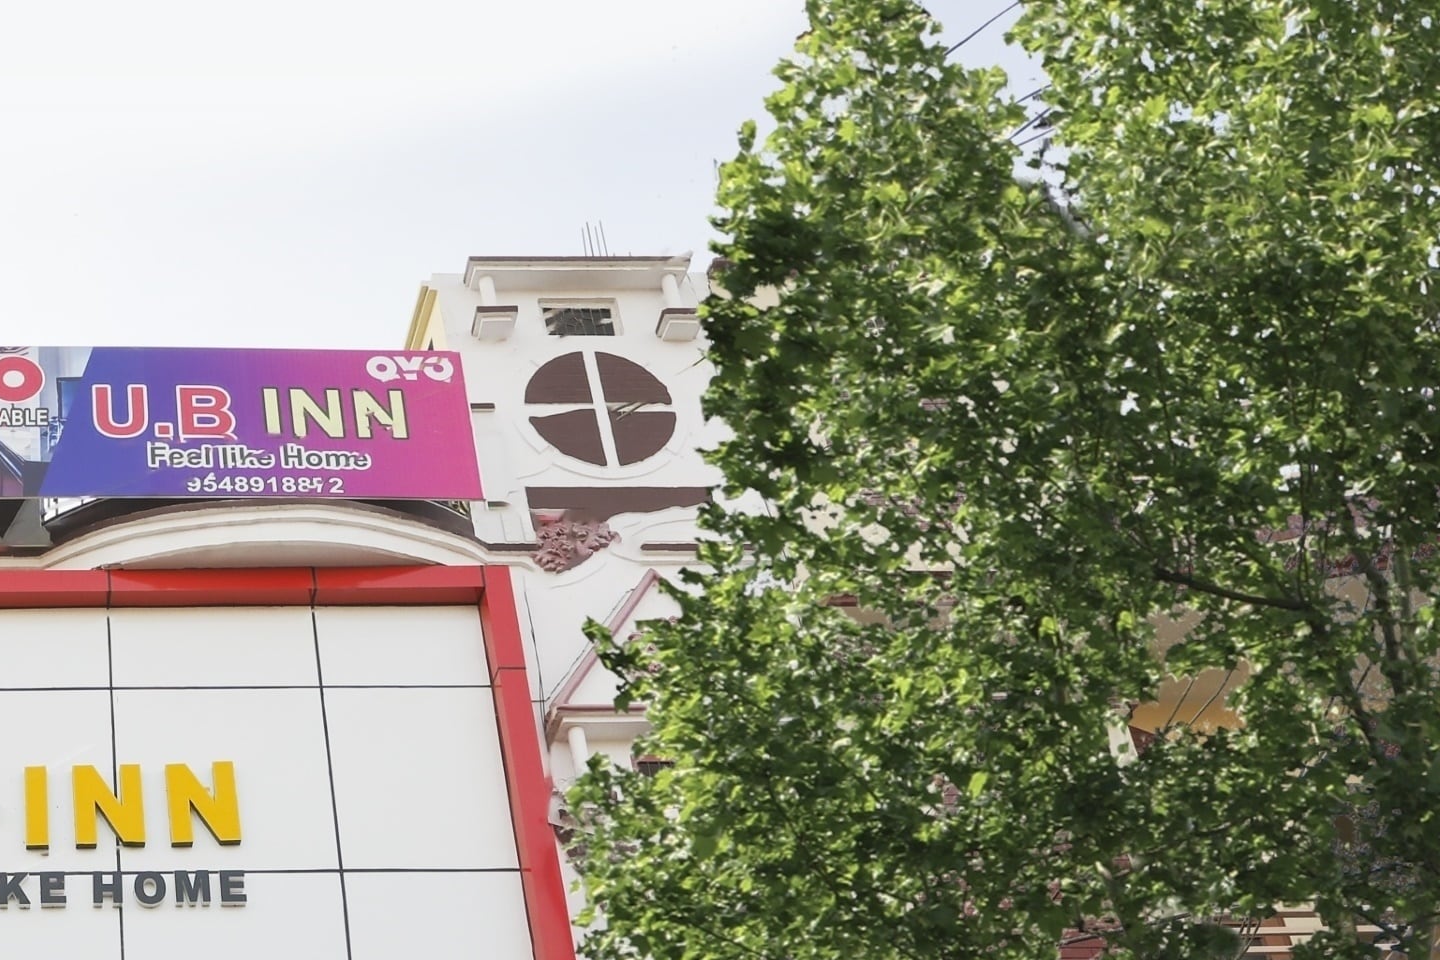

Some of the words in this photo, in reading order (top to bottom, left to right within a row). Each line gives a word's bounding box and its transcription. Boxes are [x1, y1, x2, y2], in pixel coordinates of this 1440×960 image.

[92, 384, 237, 440] U.B
[262, 387, 409, 439] INN
[147, 442, 214, 468] Feel
[280, 443, 372, 470] Home
[92, 869, 248, 910] HOME
